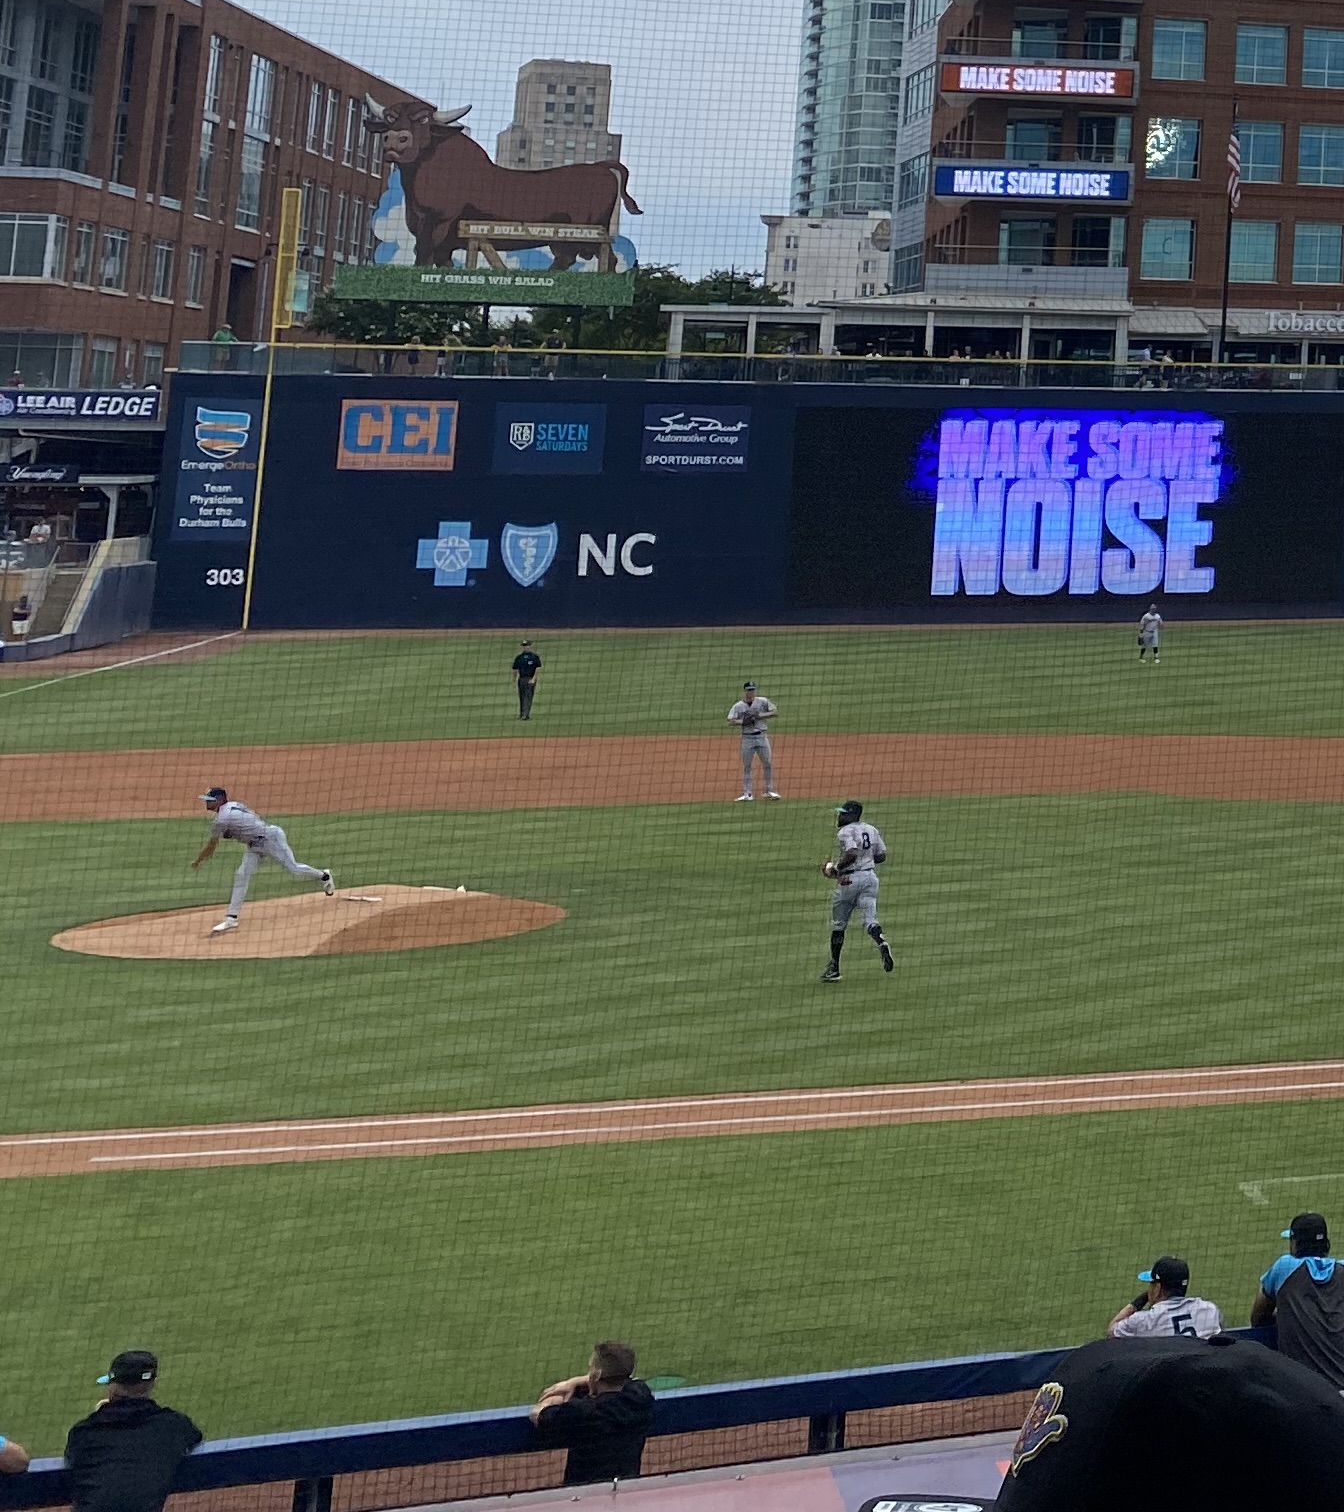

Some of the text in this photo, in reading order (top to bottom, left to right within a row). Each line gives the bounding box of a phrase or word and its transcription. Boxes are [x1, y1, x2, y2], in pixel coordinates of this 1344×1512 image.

[959, 67, 1116, 94] MAKE SOME NOISE
[954, 170, 1110, 196] MAKE SOME NOISE
[528, 226, 554, 236] WIN
[421, 274, 554, 286] HIT GRASS WIN SALAD
[17, 396, 76, 408] LEE AIR
[80, 397, 156, 416] LEDGE
[344, 405, 455, 455] CEI
[536, 424, 589, 440] SEVEN
[536, 441, 588, 451] SATURDAYS
[653, 433, 738, 445] Automotive Group
[937, 419, 1224, 480] MAKE SOME
[645, 455, 743, 465] SPORTDURST.COM
[204, 484, 231, 492] Team
[190, 495, 243, 505] Physicians
[179, 518, 219, 527] Durham
[930, 477, 1220, 595] NOISE
[578, 532, 656, 576] NC
[206, 569, 244, 586] 303
[1172, 1313, 1197, 1338] 5
